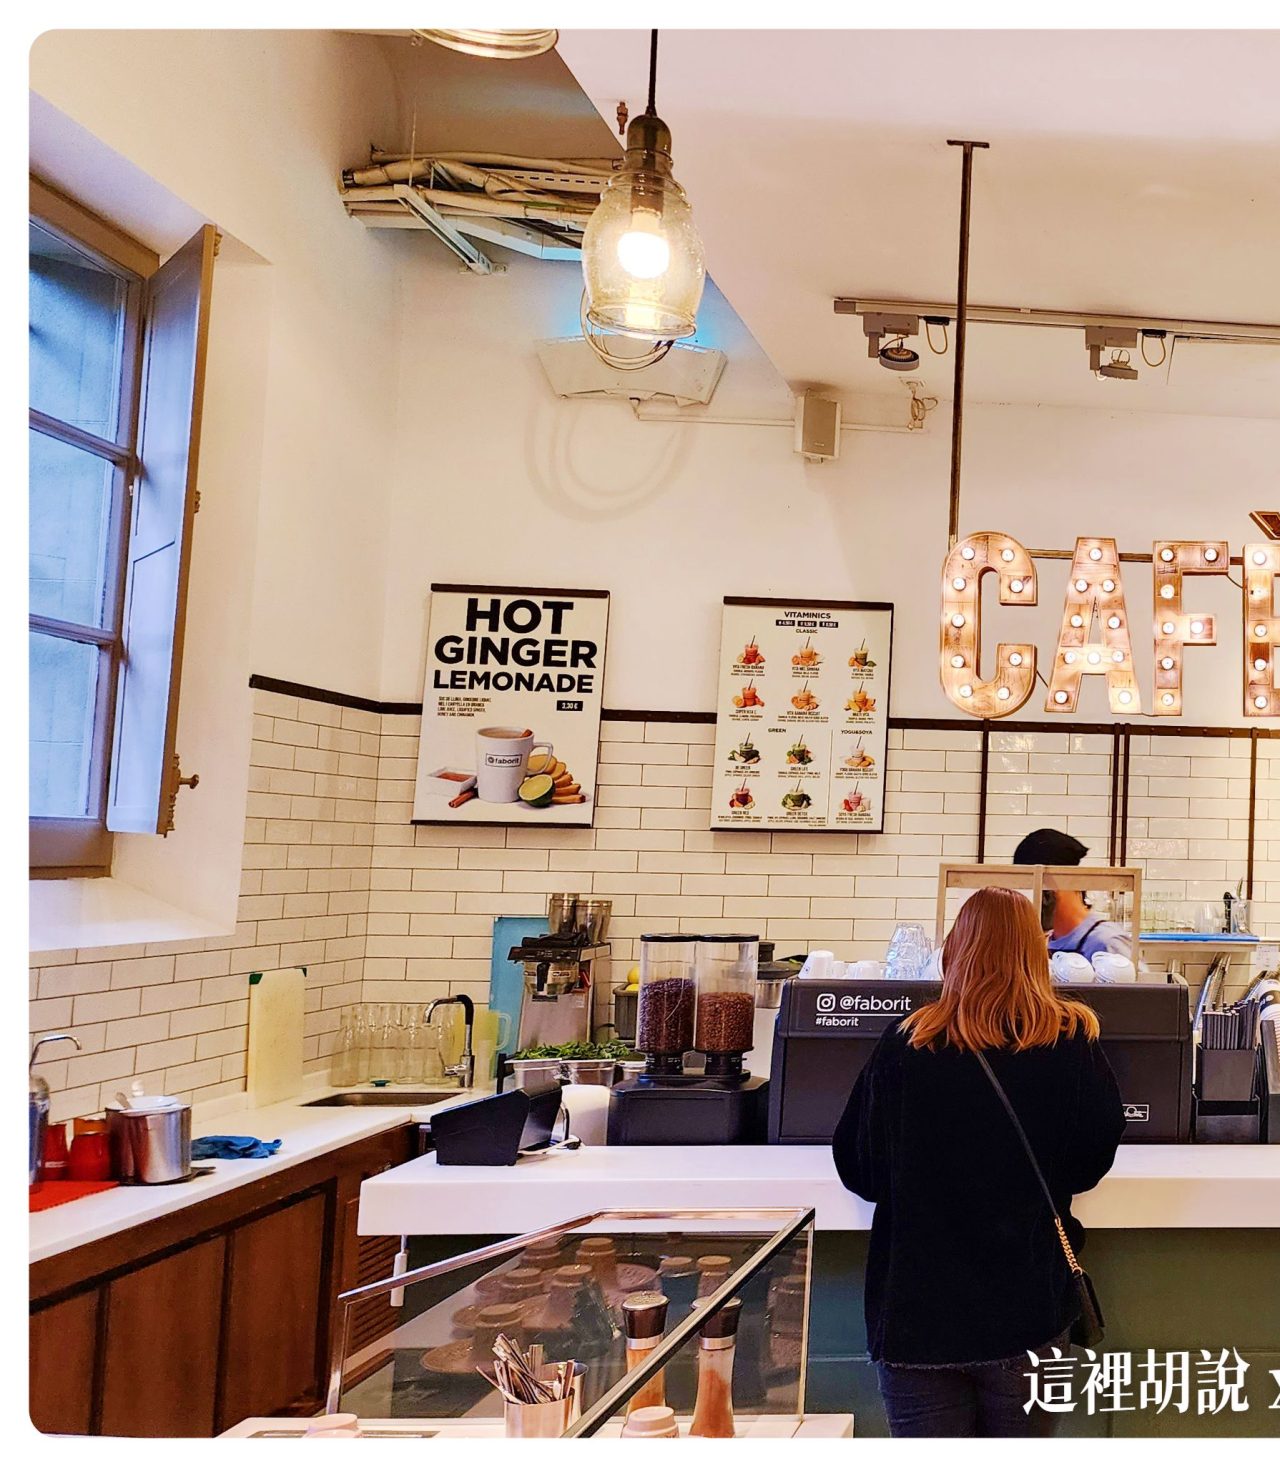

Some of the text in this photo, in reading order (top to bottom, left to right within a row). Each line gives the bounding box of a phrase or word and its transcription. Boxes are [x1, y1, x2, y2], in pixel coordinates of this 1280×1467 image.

[466, 598, 574, 634] HOT
[784, 611, 831, 619] VITAMINICS
[434, 635, 598, 668] GINGER
[433, 670, 594, 693] LEMONADE
[840, 995, 911, 1011] @faborit
[815, 1016, 859, 1026] #faborit
